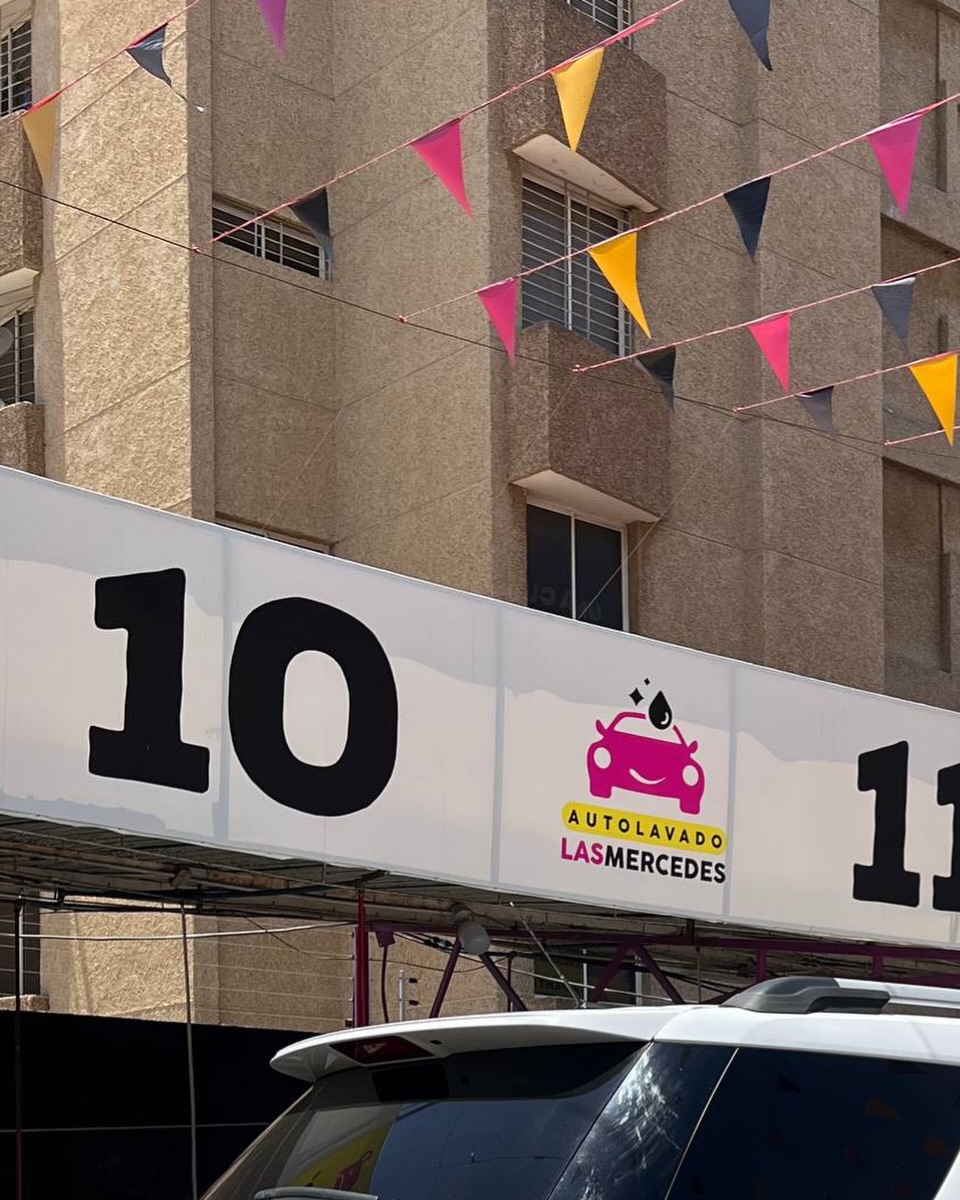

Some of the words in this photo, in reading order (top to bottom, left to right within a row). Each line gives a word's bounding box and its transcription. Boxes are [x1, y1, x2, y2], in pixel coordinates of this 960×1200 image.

[89, 567, 398, 817] 10
[568, 809, 723, 849] AUTOLAVADO
[561, 837, 726, 884] LASMERCEDES
